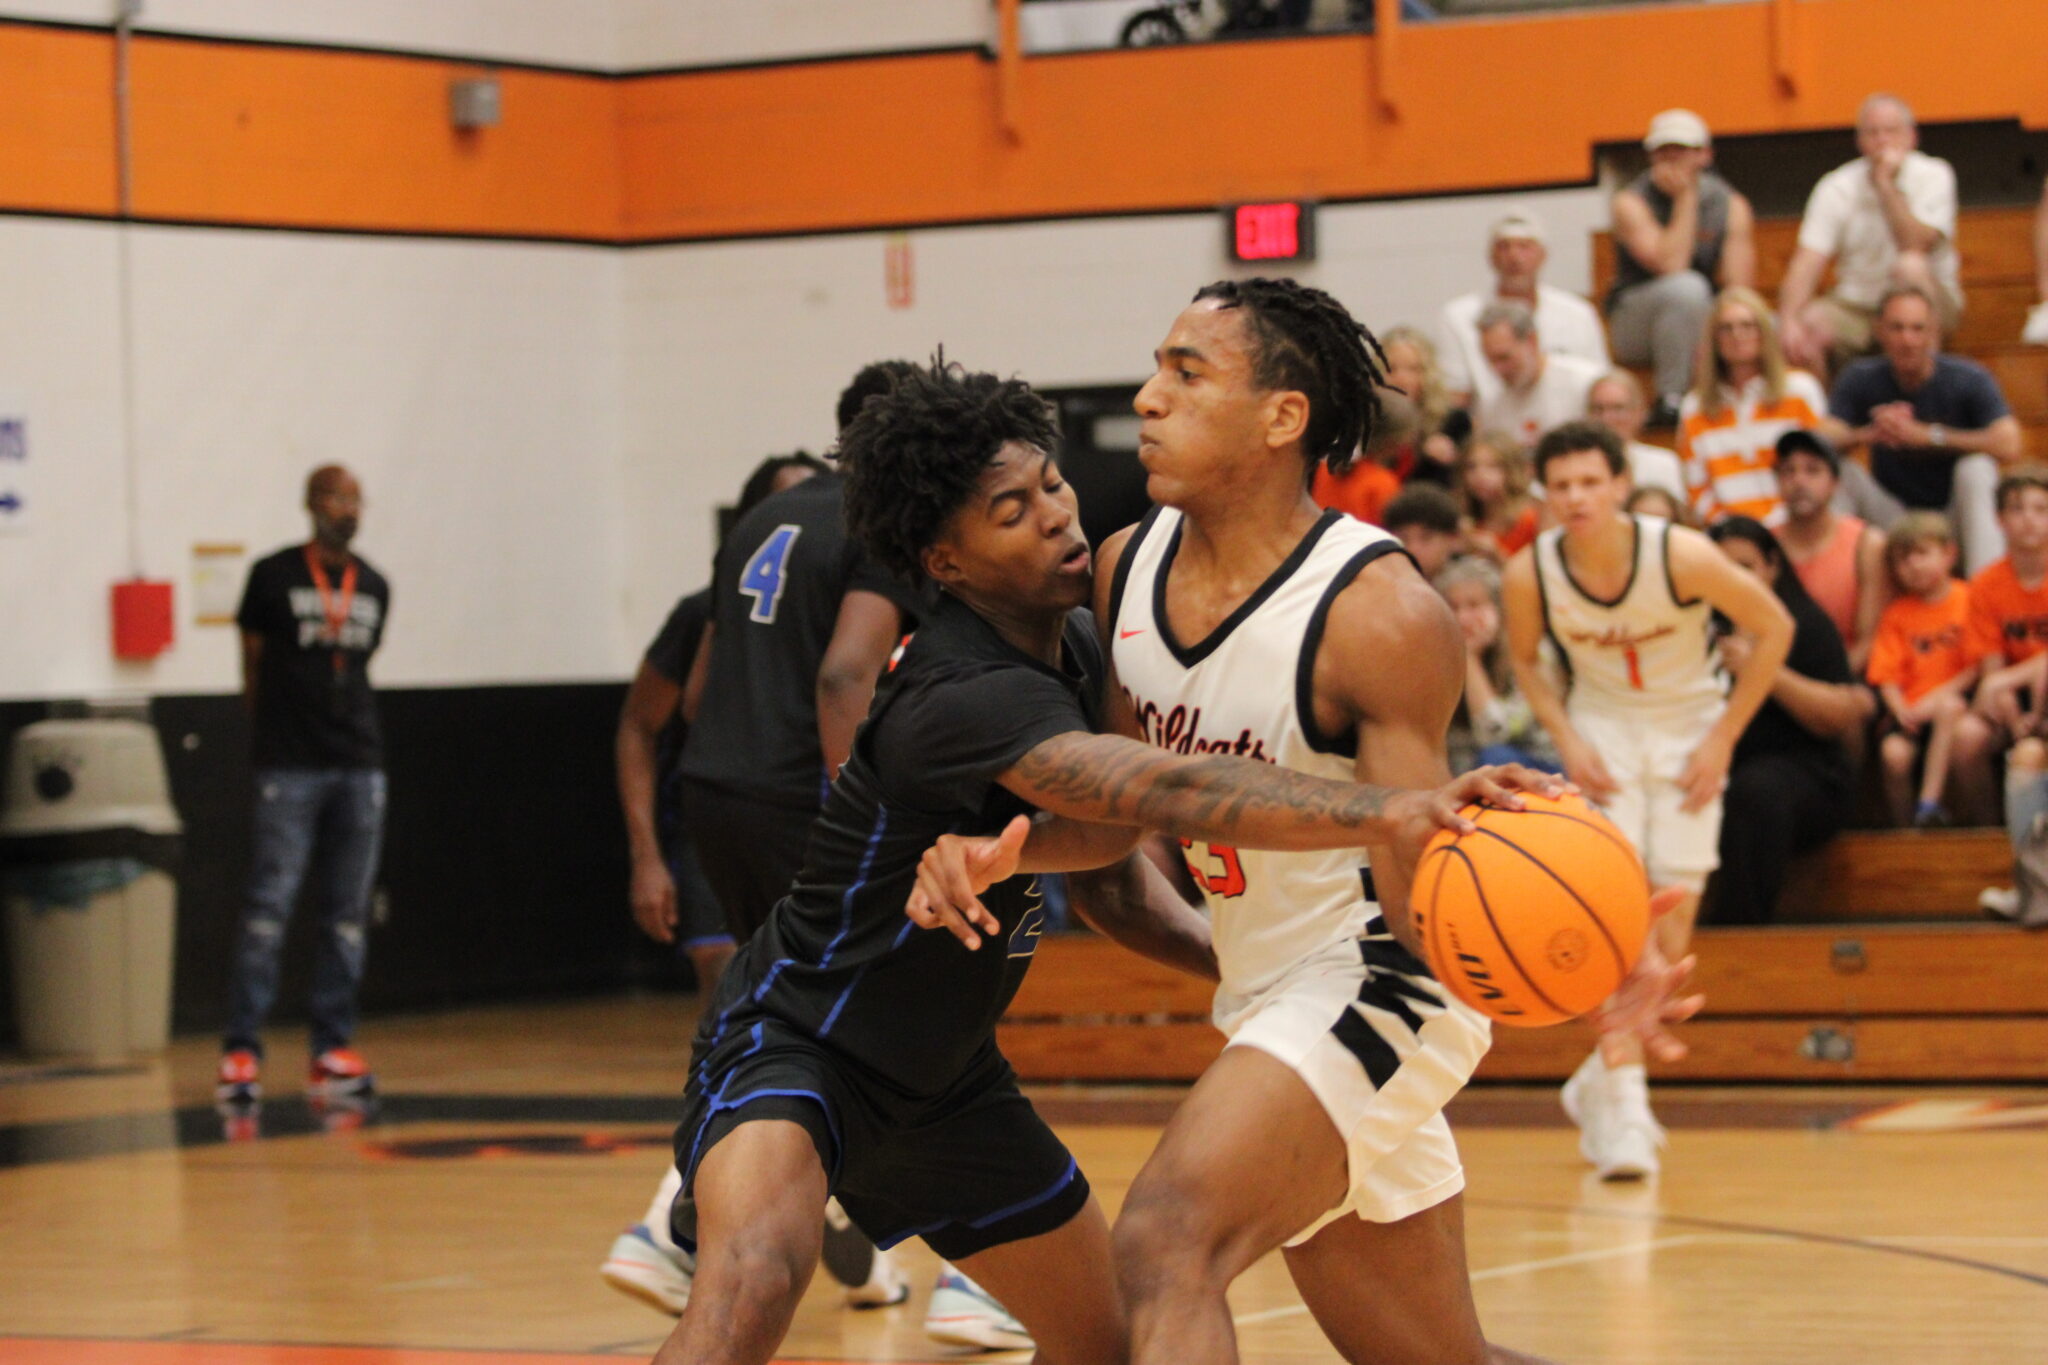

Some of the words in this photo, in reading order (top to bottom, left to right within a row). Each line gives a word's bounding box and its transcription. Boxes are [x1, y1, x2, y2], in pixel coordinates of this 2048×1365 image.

[1235, 203, 1299, 259] EXIT
[738, 523, 803, 624] 4
[1624, 641, 1645, 692] 1
